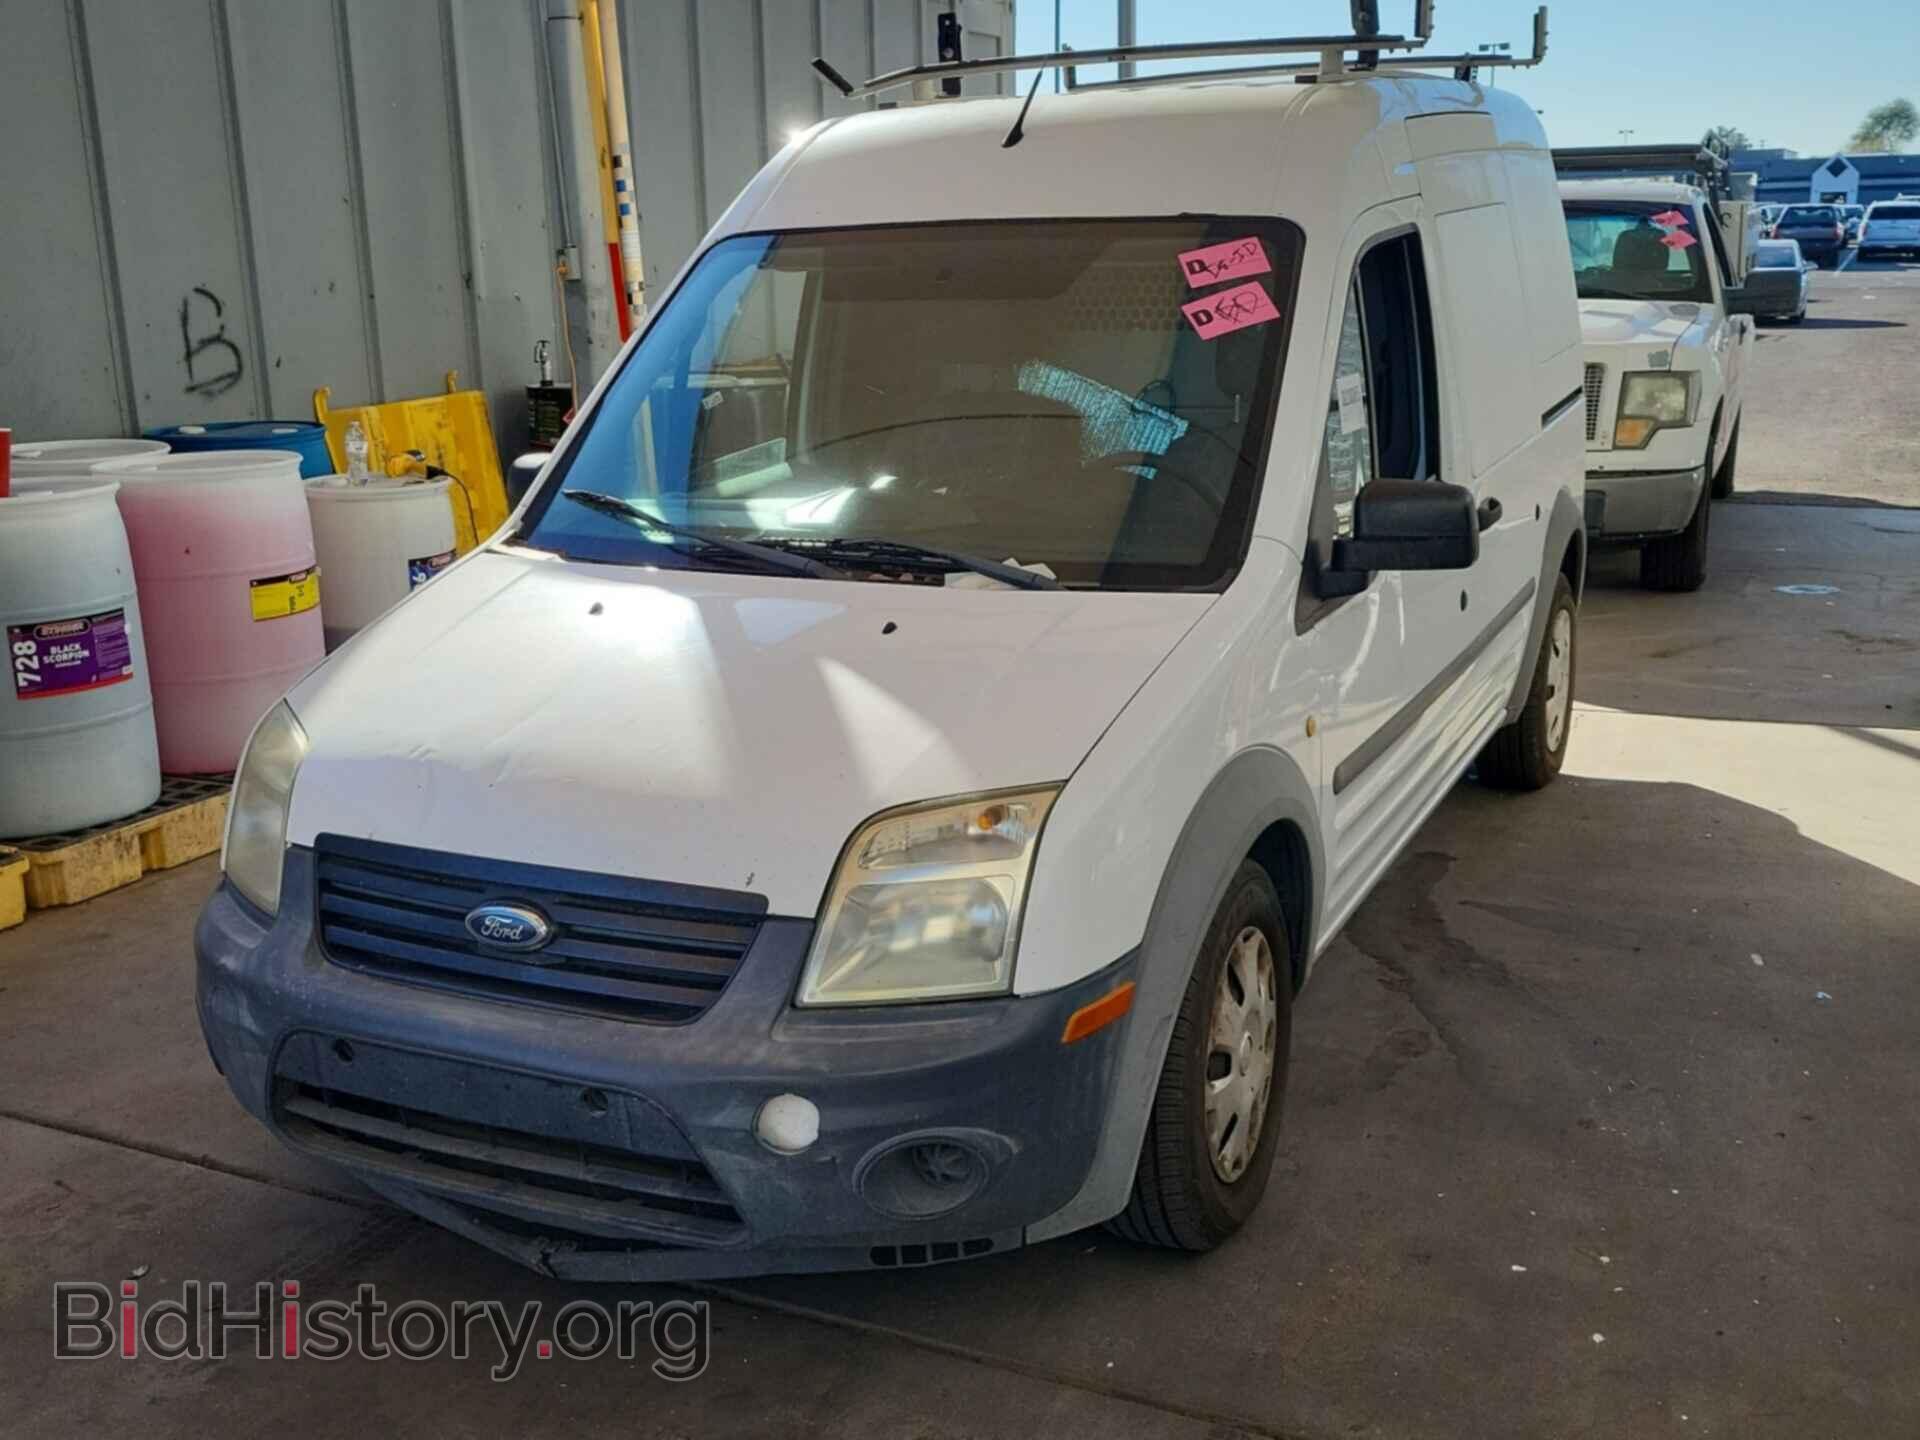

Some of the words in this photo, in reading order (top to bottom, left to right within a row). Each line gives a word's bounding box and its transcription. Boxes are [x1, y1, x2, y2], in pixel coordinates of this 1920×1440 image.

[1187, 259, 1207, 275] D
[1191, 309, 1214, 327] D
[180, 287, 243, 397] B
[49, 643, 82, 655] BLACK
[13, 640, 42, 688] 728
[481, 915, 523, 940] Ford
